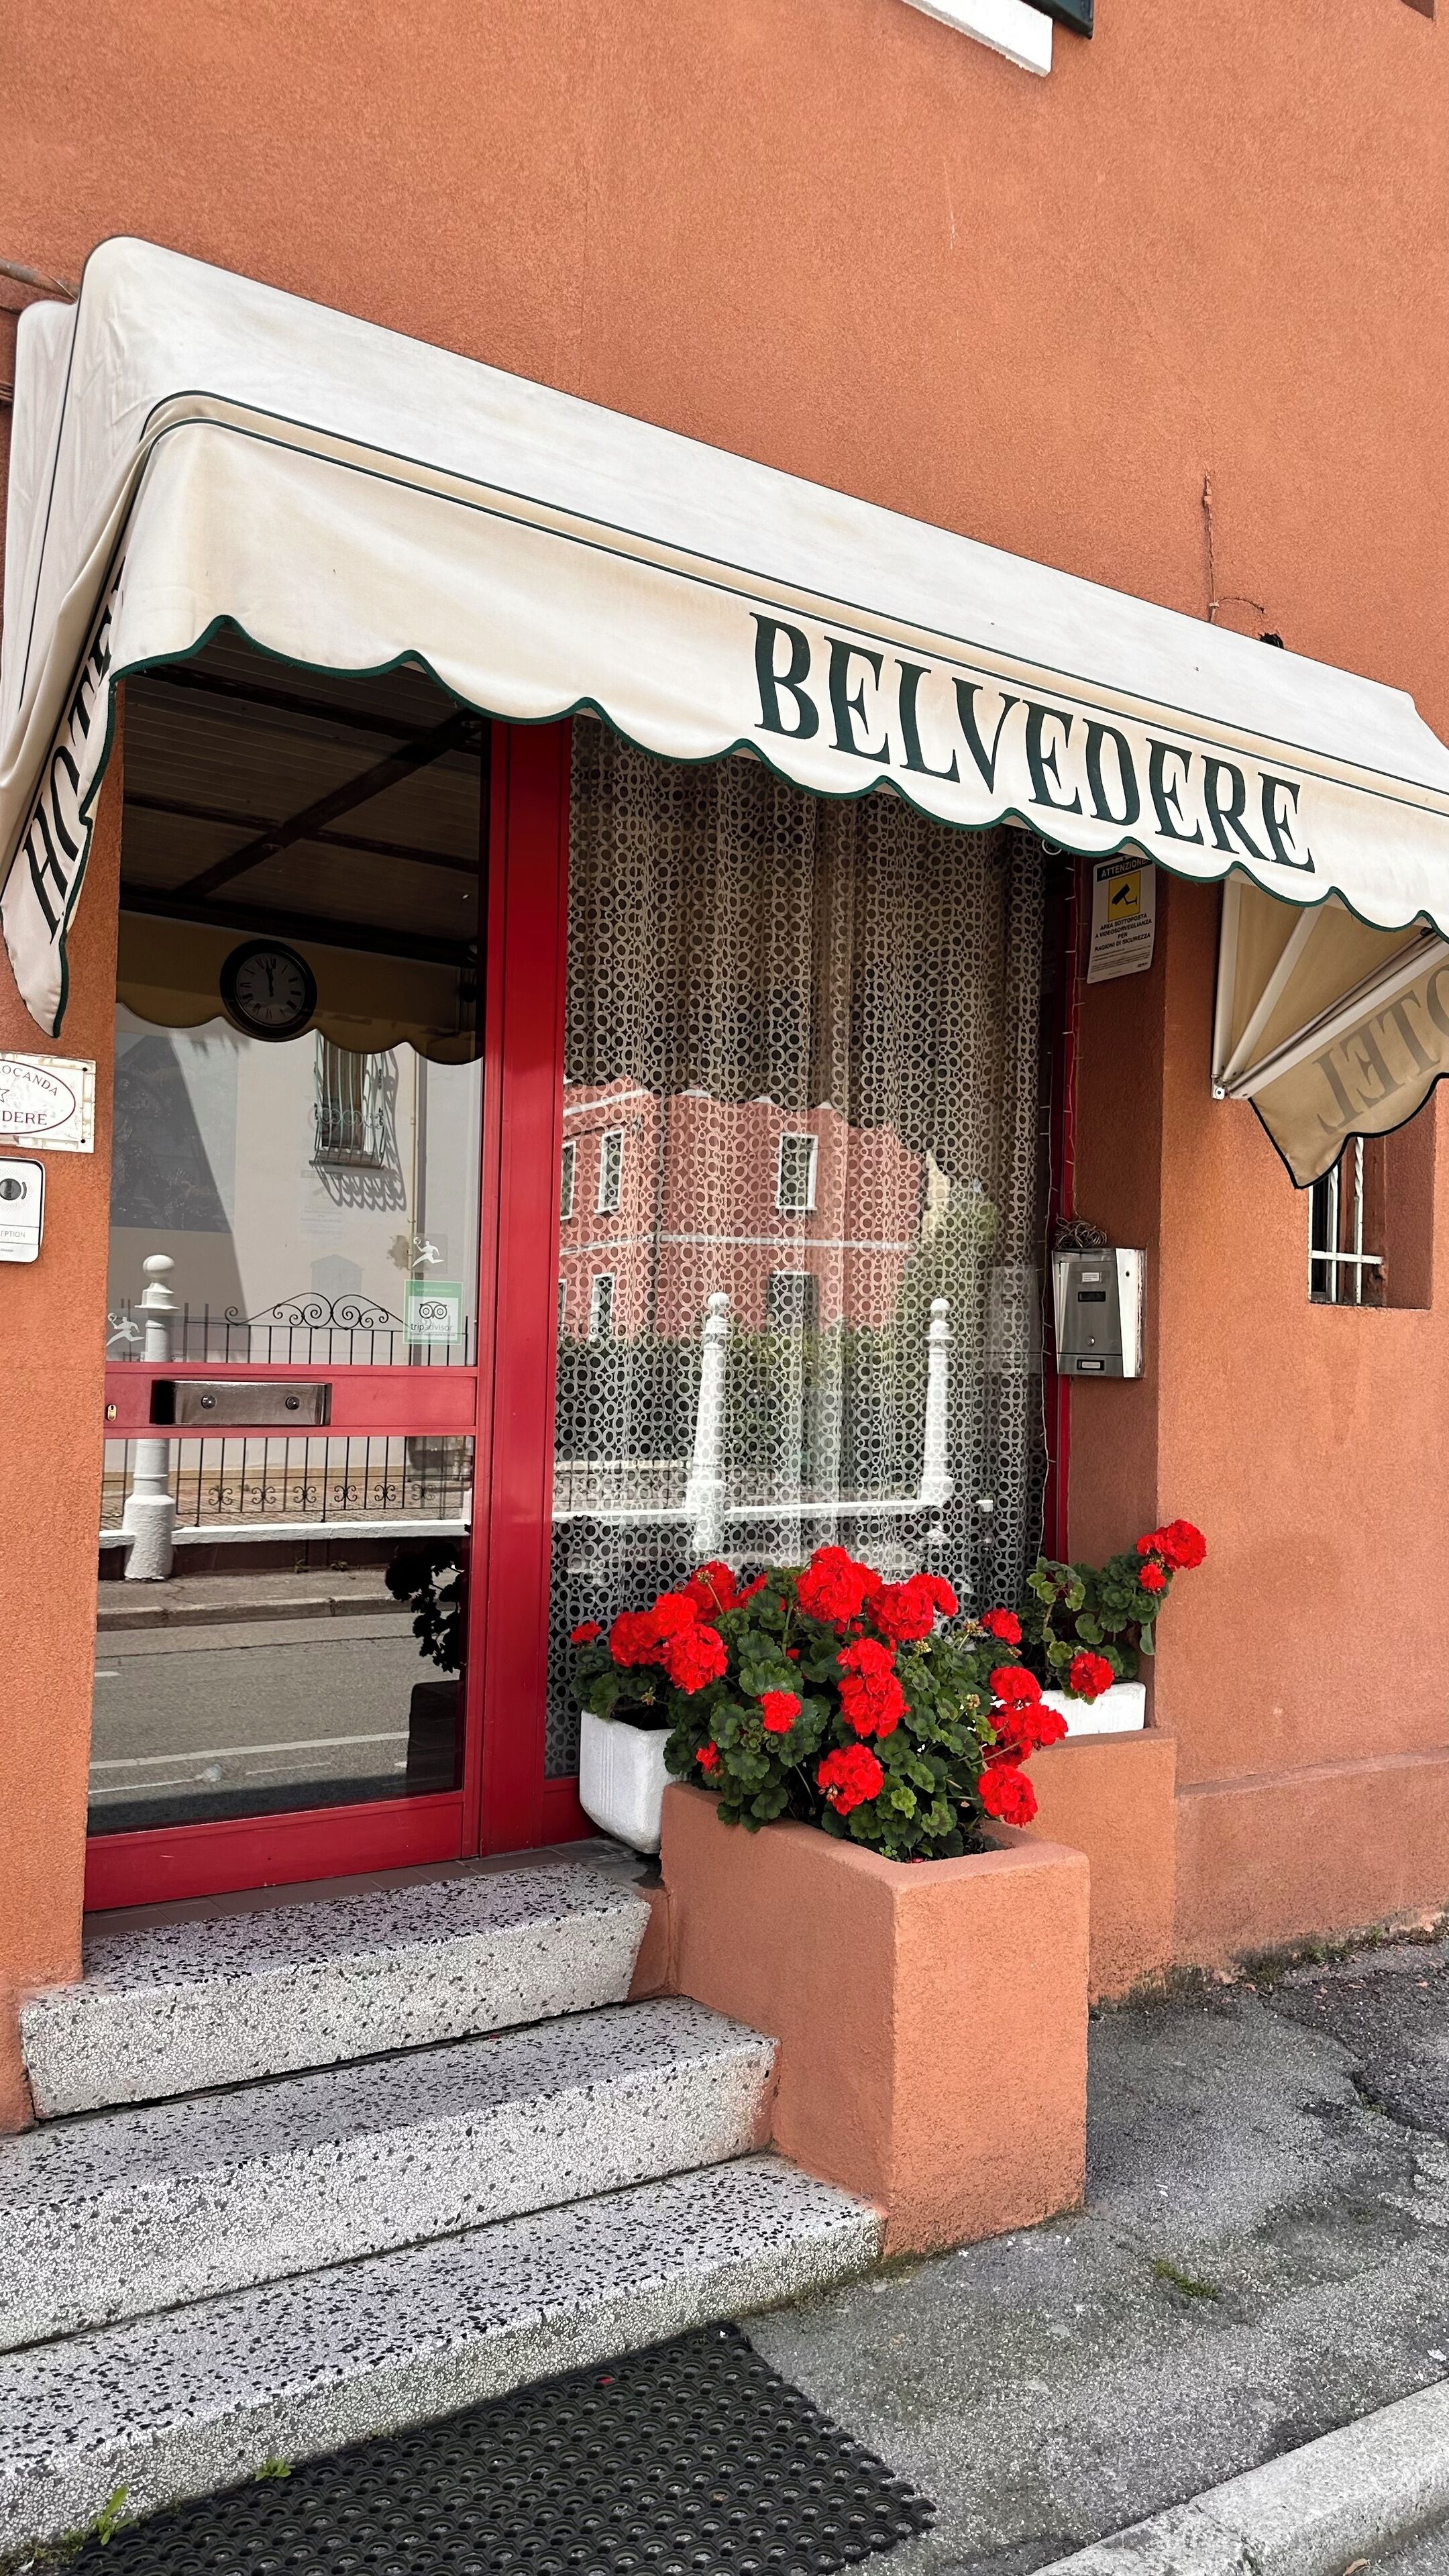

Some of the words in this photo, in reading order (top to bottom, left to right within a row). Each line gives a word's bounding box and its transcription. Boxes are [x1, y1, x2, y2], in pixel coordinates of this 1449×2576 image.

[749, 611, 1316, 873] BELVEDERE
[1099, 918, 1152, 938] VIDEOSORVEGLIANZA
[1100, 922, 1114, 930] AREA
[1114, 913, 1147, 927] SOTTOPOSTA
[1095, 942, 1115, 951] RAGIONI
[1122, 932, 1150, 945] SICUREZZA
[0, 1065, 58, 1097] OCANDA
